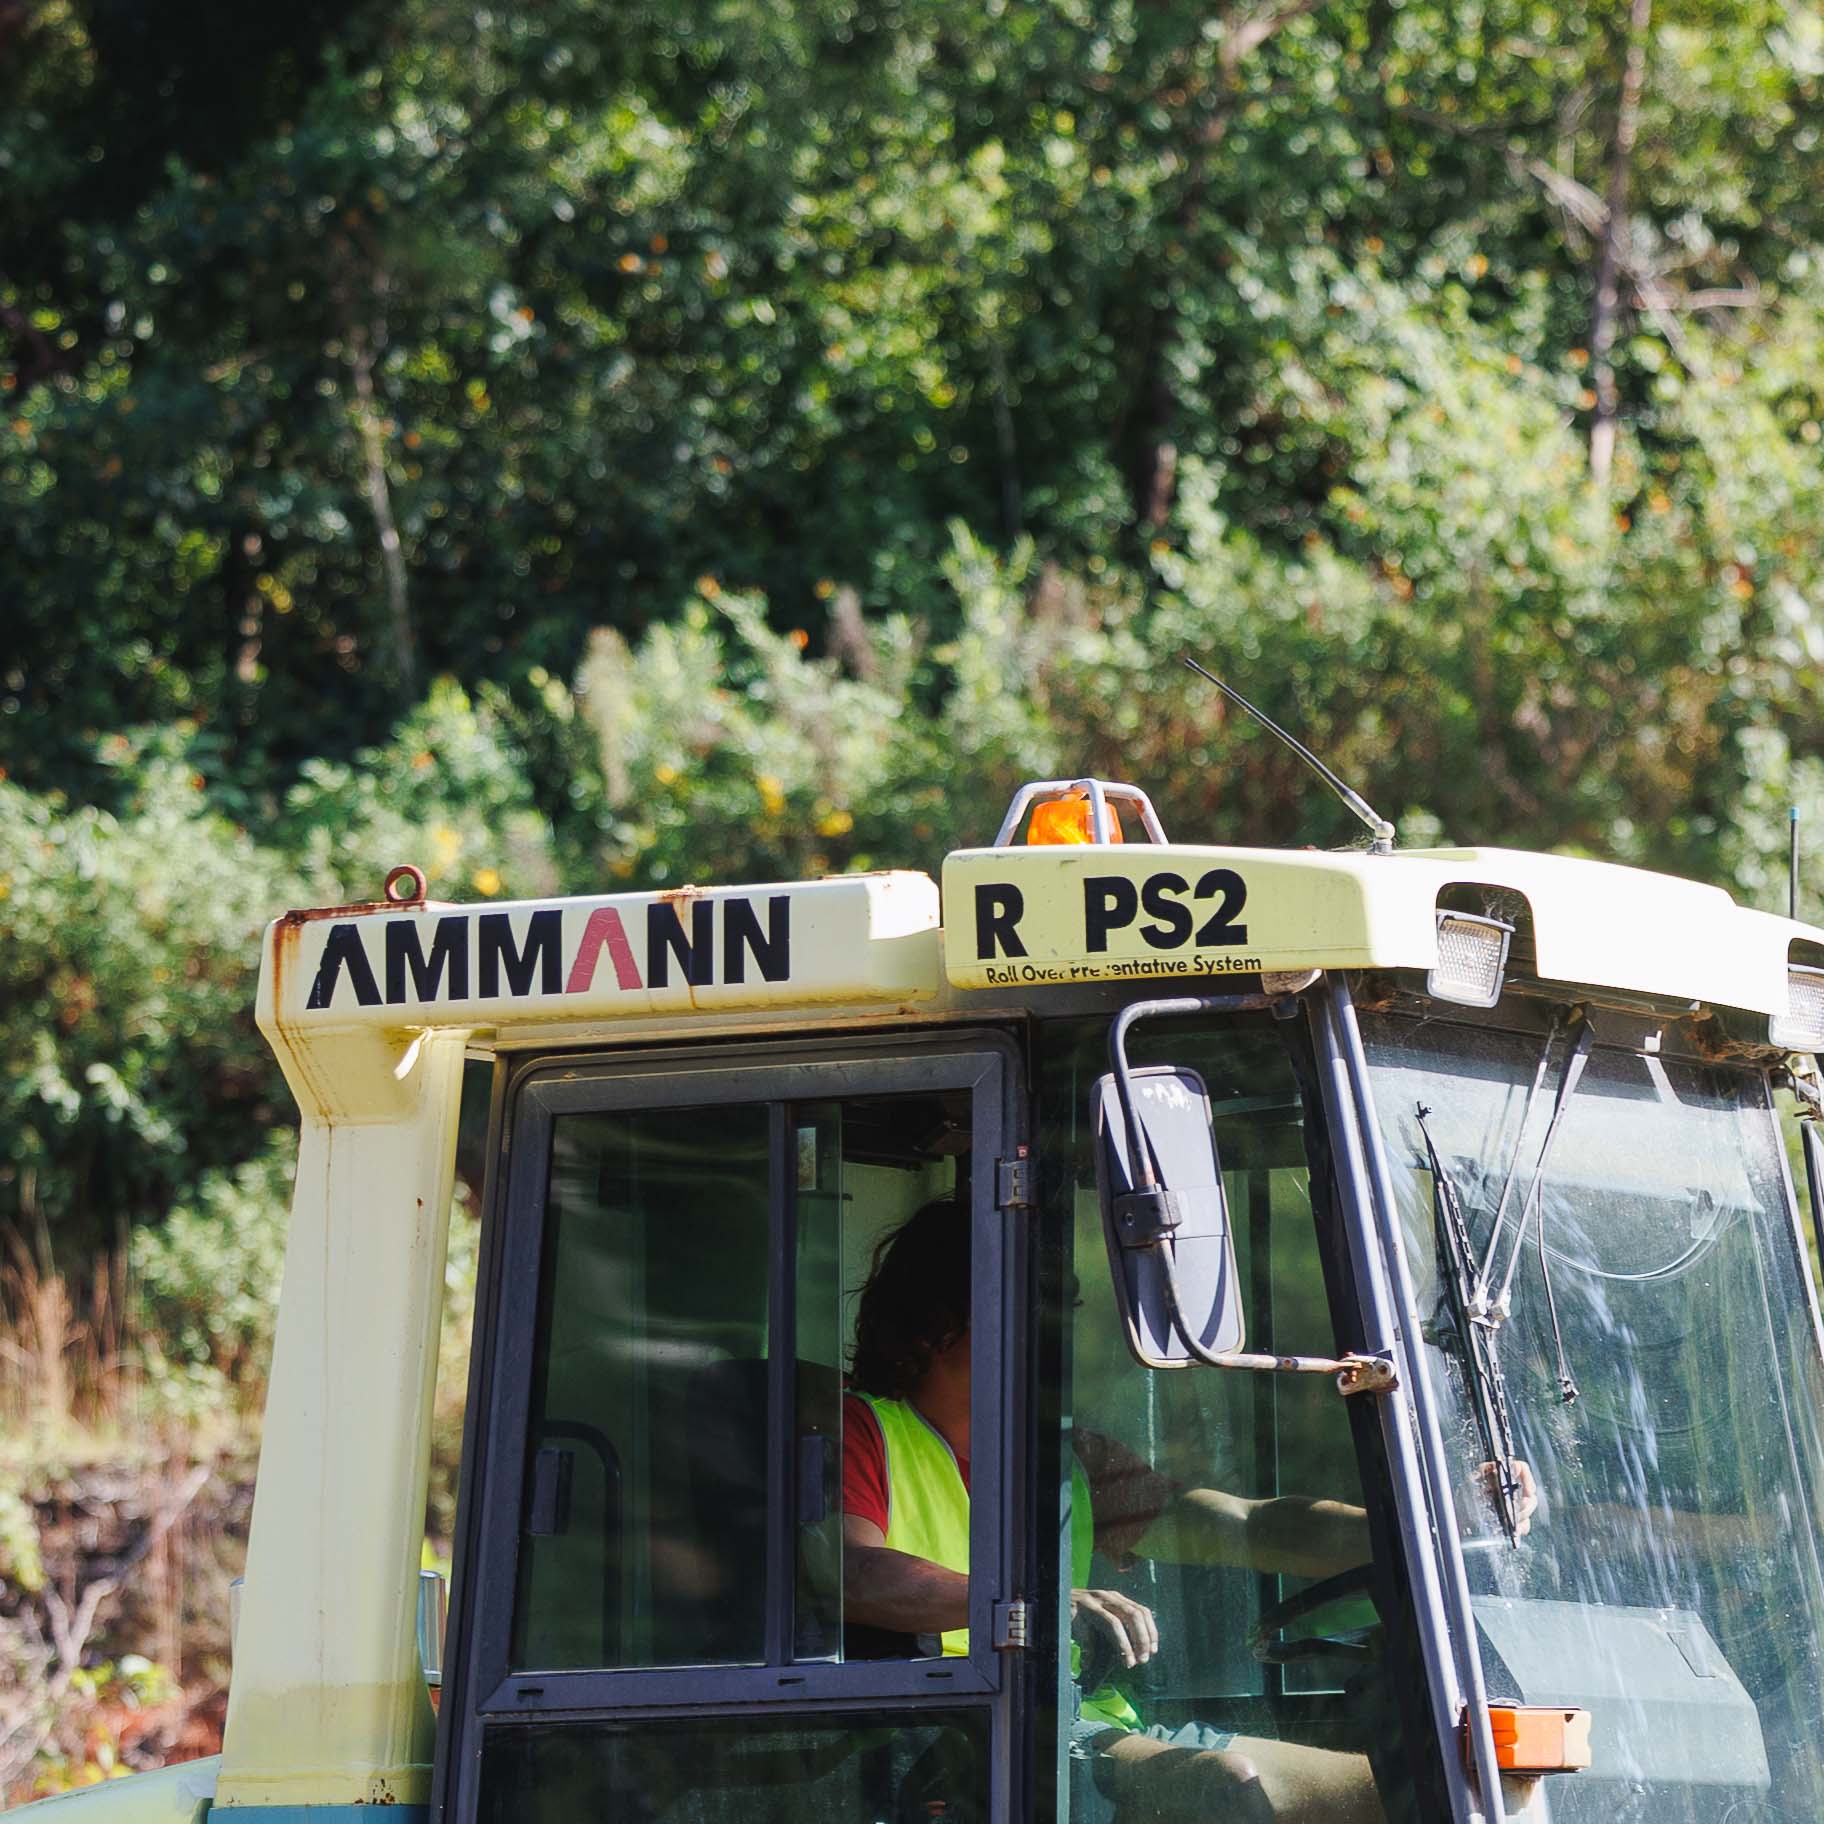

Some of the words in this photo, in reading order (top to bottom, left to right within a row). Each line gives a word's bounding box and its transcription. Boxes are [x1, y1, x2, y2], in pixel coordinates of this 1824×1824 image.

[306, 896, 790, 1010] AMMANN
[987, 966, 1018, 984] Roll
[1193, 954, 1262, 975] System
